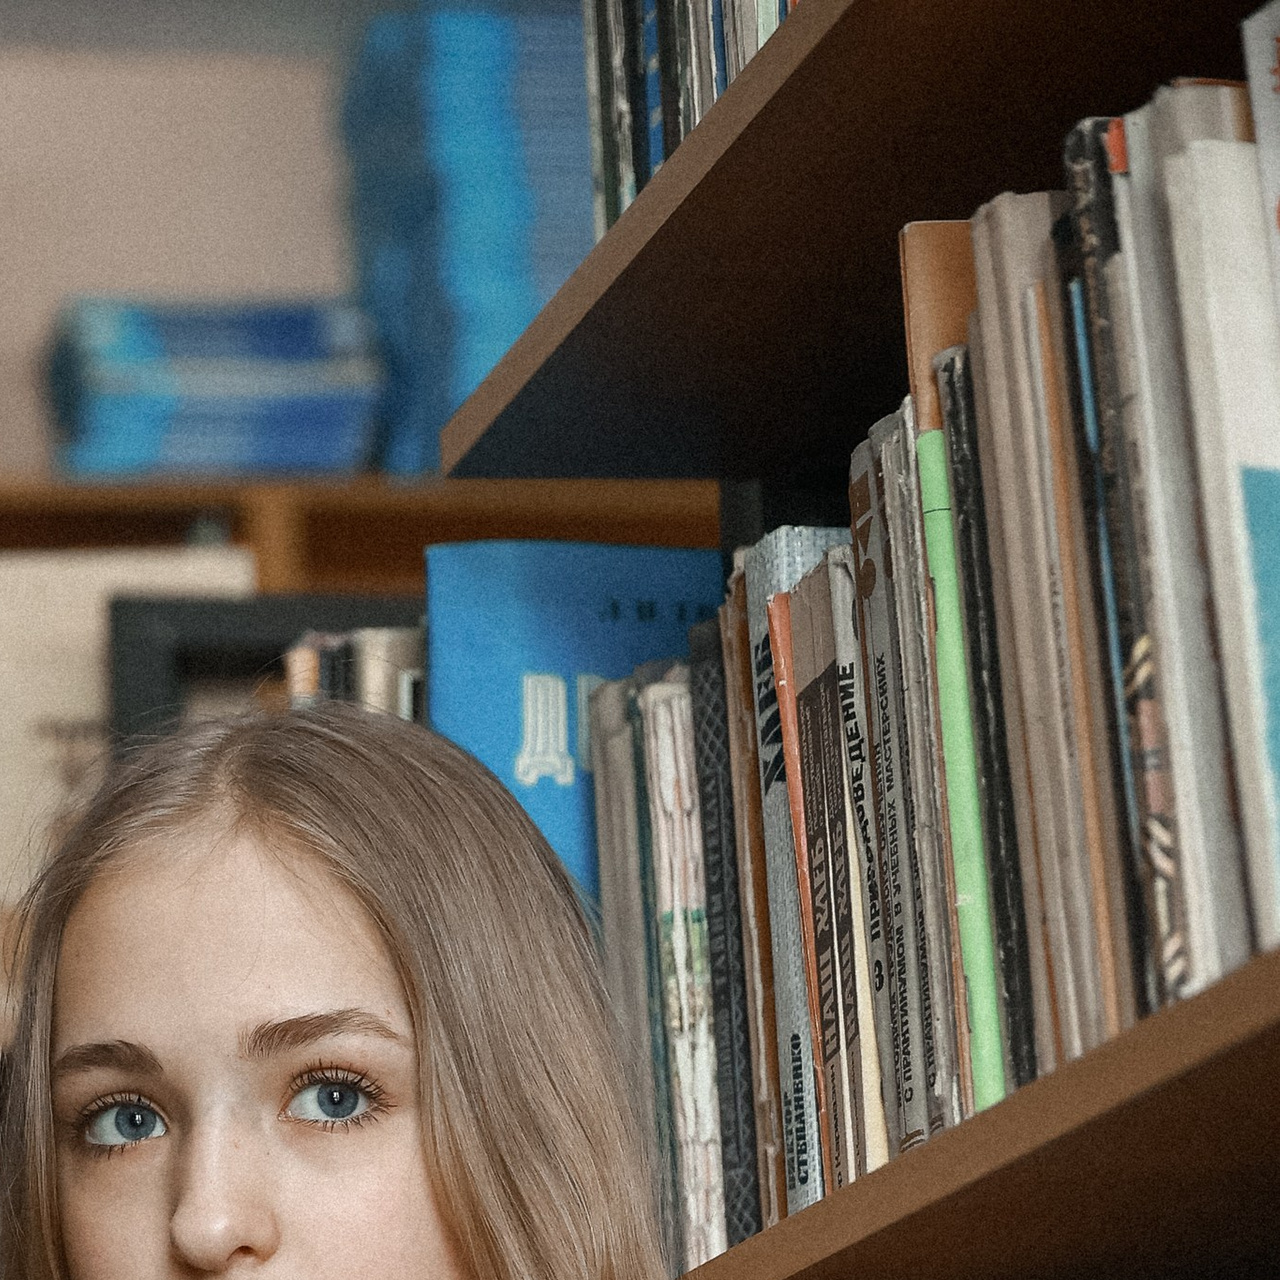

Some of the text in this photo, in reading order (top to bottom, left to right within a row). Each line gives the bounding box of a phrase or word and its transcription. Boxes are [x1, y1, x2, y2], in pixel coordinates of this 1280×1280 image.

[875, 651, 895, 793] МАСТЕРСКИХ
[886, 798, 902, 898] УЧЕБНЫХ
[892, 901, 902, 917] В
[810, 837, 838, 1057] НАШ ХЛЕБ
[832, 820, 856, 1040] НАШ ХЛЕБ
[790, 1033, 809, 1186] СТЕПАНЕНКО
[902, 1086, 914, 1104] С
